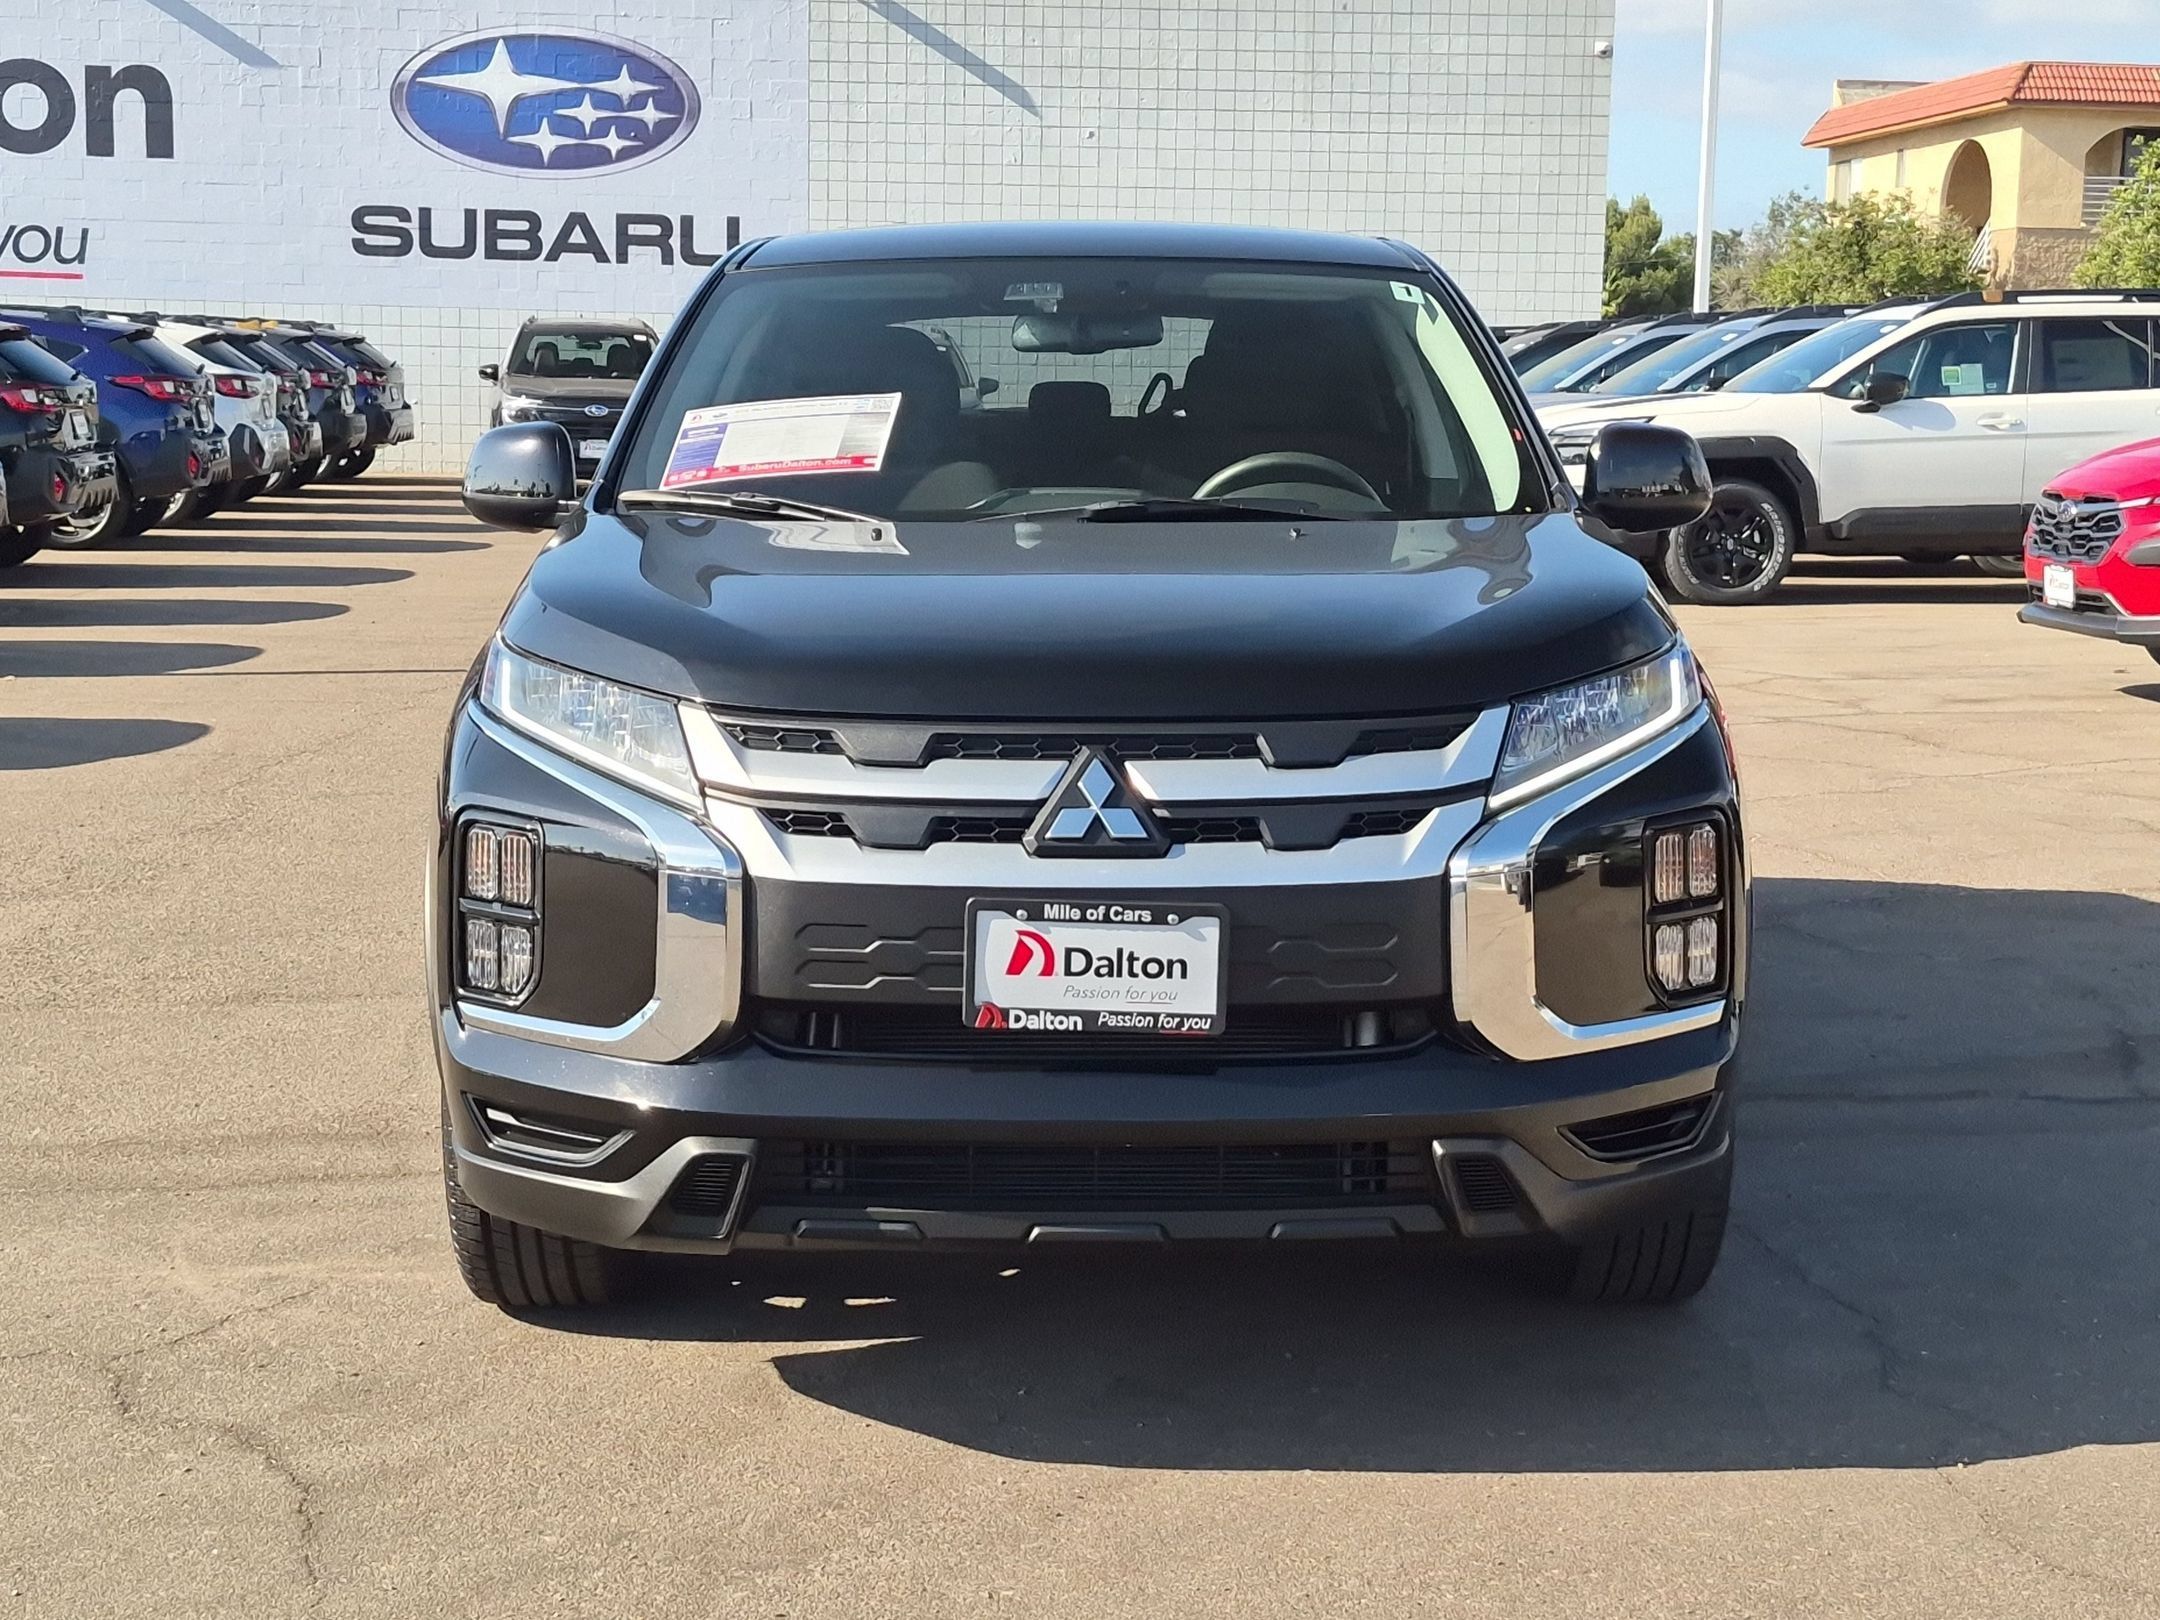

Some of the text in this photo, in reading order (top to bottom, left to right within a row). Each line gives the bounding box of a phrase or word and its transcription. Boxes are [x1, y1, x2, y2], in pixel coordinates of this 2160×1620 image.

[0, 58, 174, 159] on
[351, 205, 740, 267] SUBARU
[1043, 904, 1152, 922] Mile of Cars
[1063, 947, 1188, 980] Dalton
[1063, 985, 1179, 1003] Passion for you
[1008, 1009, 1083, 1031] Dalton
[1098, 1012, 1212, 1032] Passion for you
